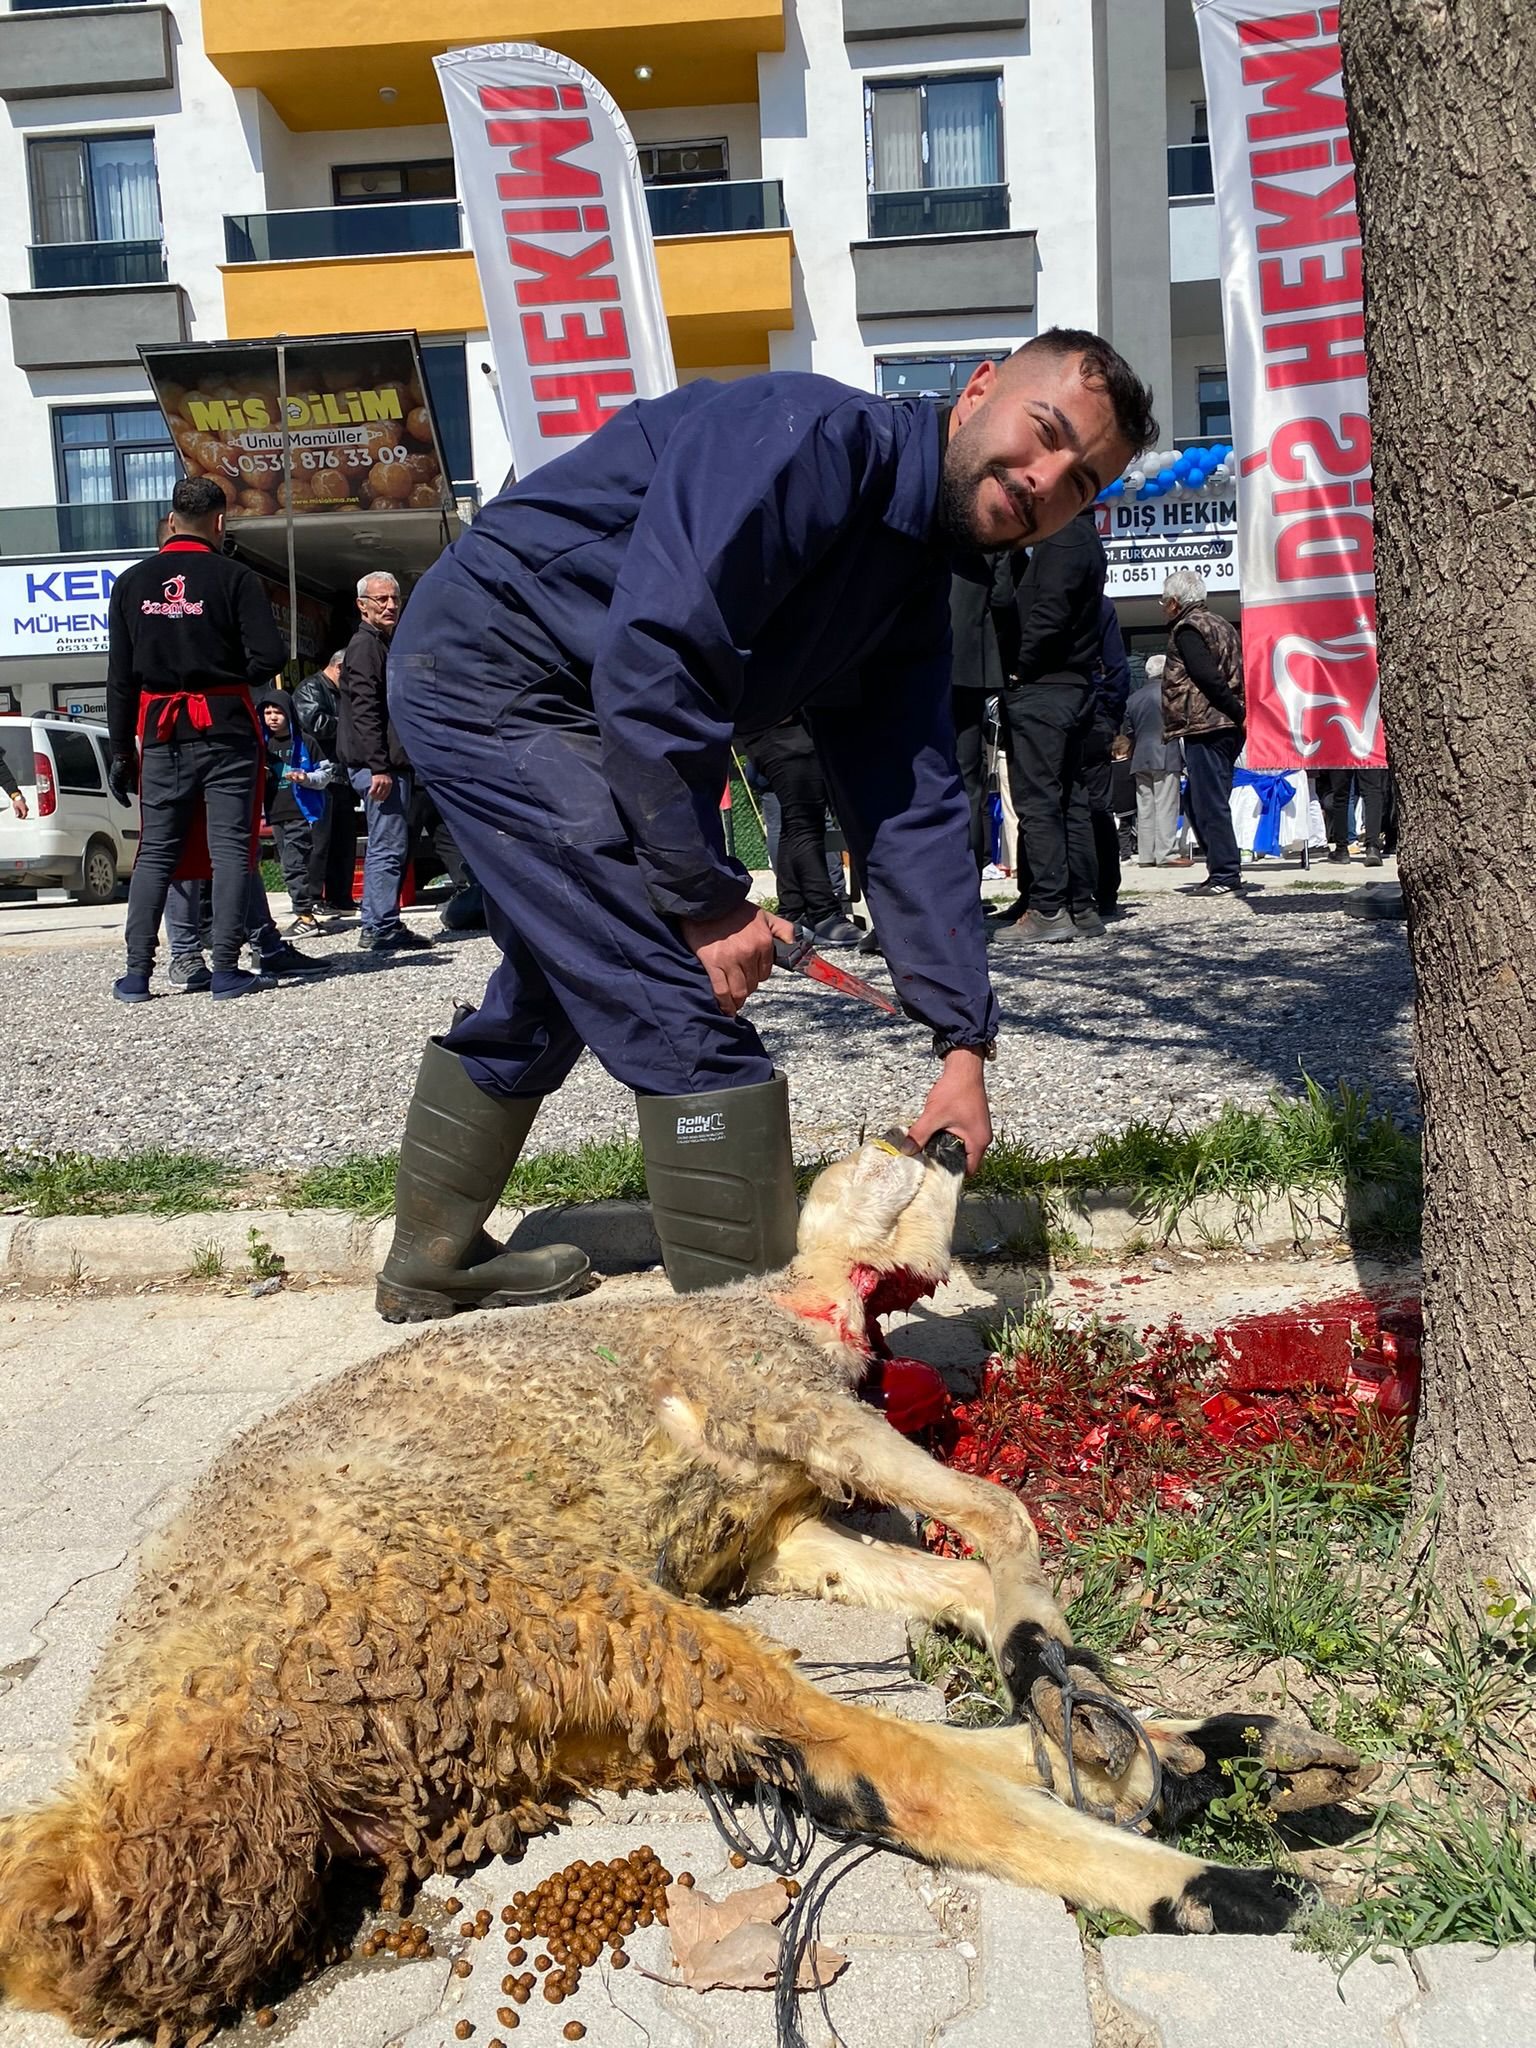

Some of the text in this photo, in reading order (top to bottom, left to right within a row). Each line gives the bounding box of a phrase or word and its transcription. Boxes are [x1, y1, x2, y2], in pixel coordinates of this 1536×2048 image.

[246, 430, 363, 449] Unlu Mamüller
[302, 450, 340, 469] 876
[346, 448, 374, 467] 33
[378, 445, 408, 465] 09
[1120, 547, 1165, 560] FURKAN
[1168, 544, 1224, 558] KARAÇAY
[1122, 567, 1156, 582] 0551
[1216, 563, 1234, 577] 30
[56, 636, 98, 645] Ahmet
[56, 644, 88, 652] 0533
[677, 1115, 711, 1126] Polly
[677, 1123, 710, 1134] Boot
